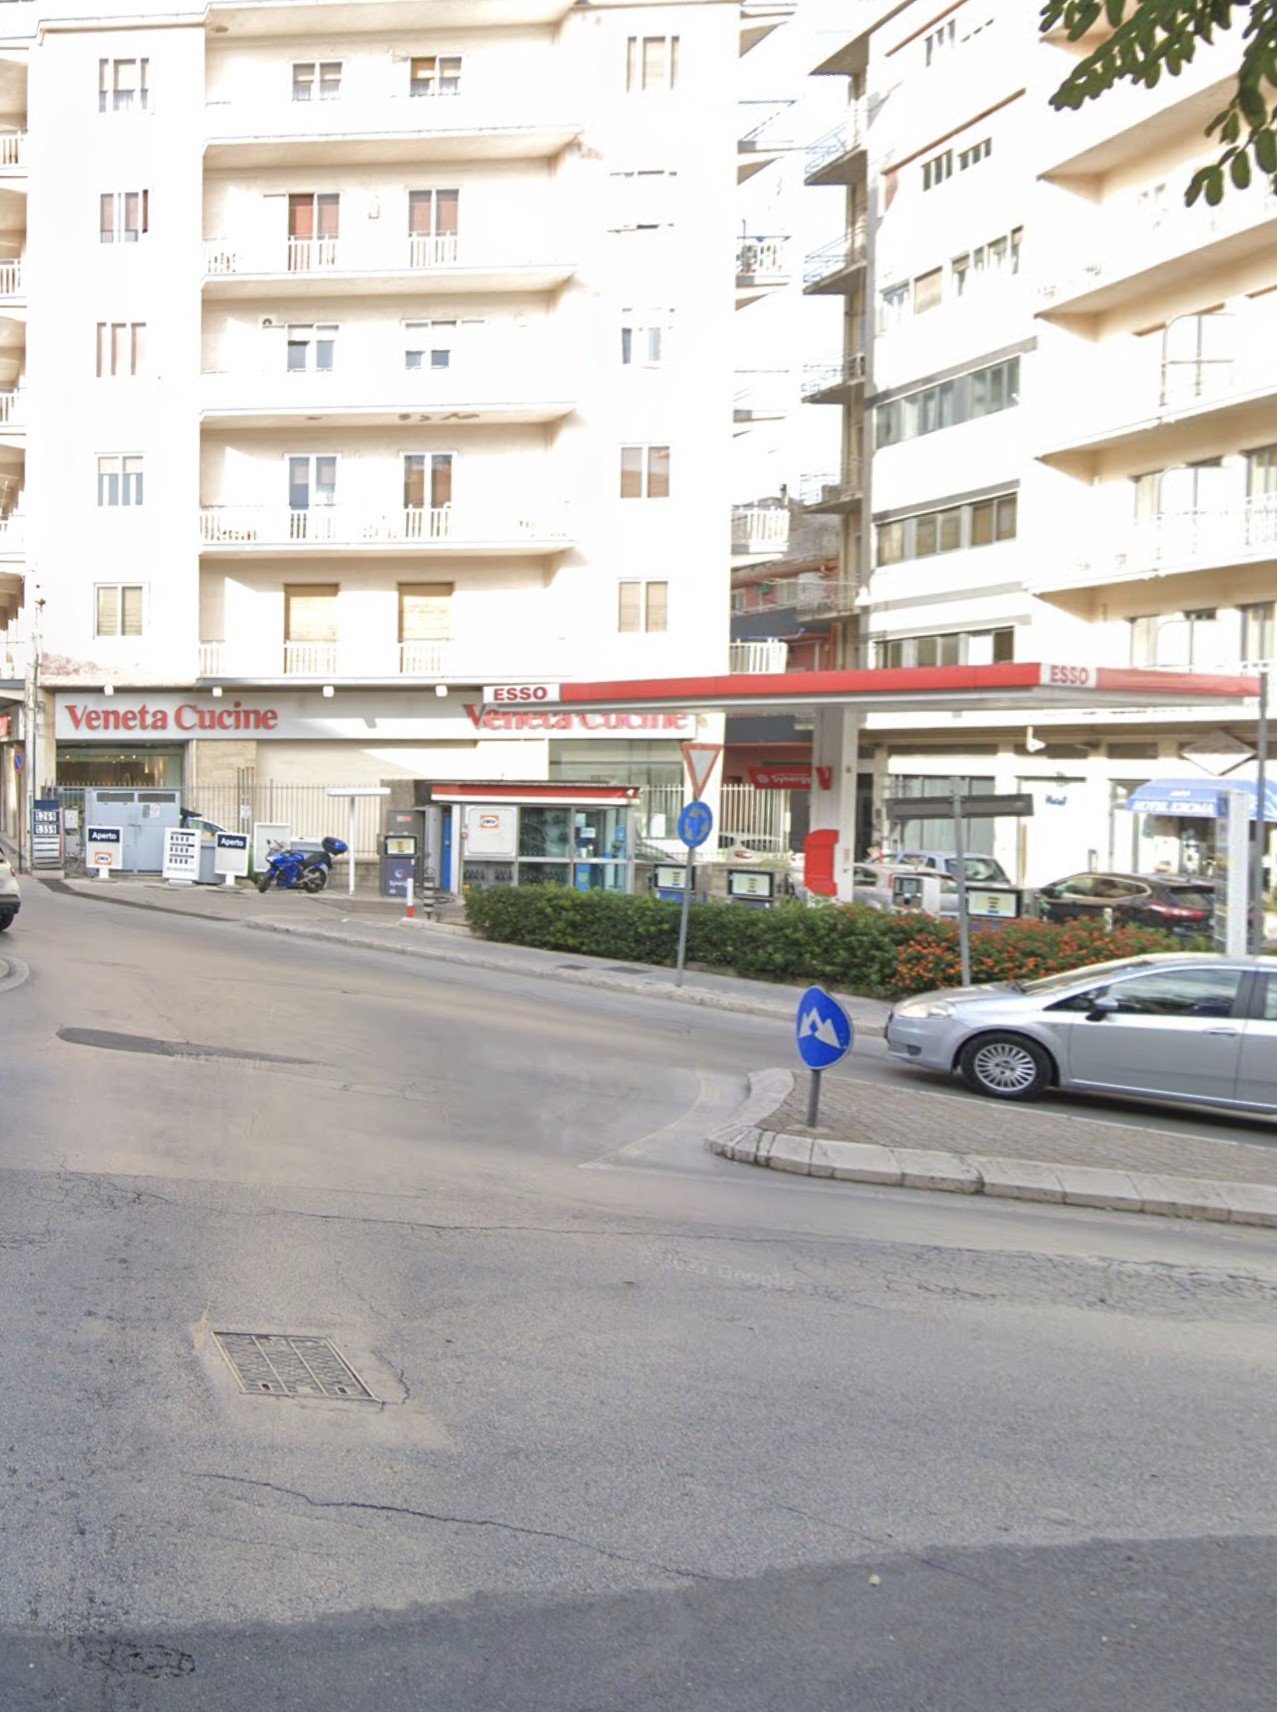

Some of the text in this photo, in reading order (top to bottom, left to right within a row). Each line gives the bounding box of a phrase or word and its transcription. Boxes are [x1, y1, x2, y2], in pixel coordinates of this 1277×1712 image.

[1050, 665, 1088, 684] ESSO
[493, 686, 548, 701] ESSO
[65, 701, 278, 730] Veneta Cucine
[92, 831, 117, 840] Aperto
[221, 837, 244, 847] Aperto
